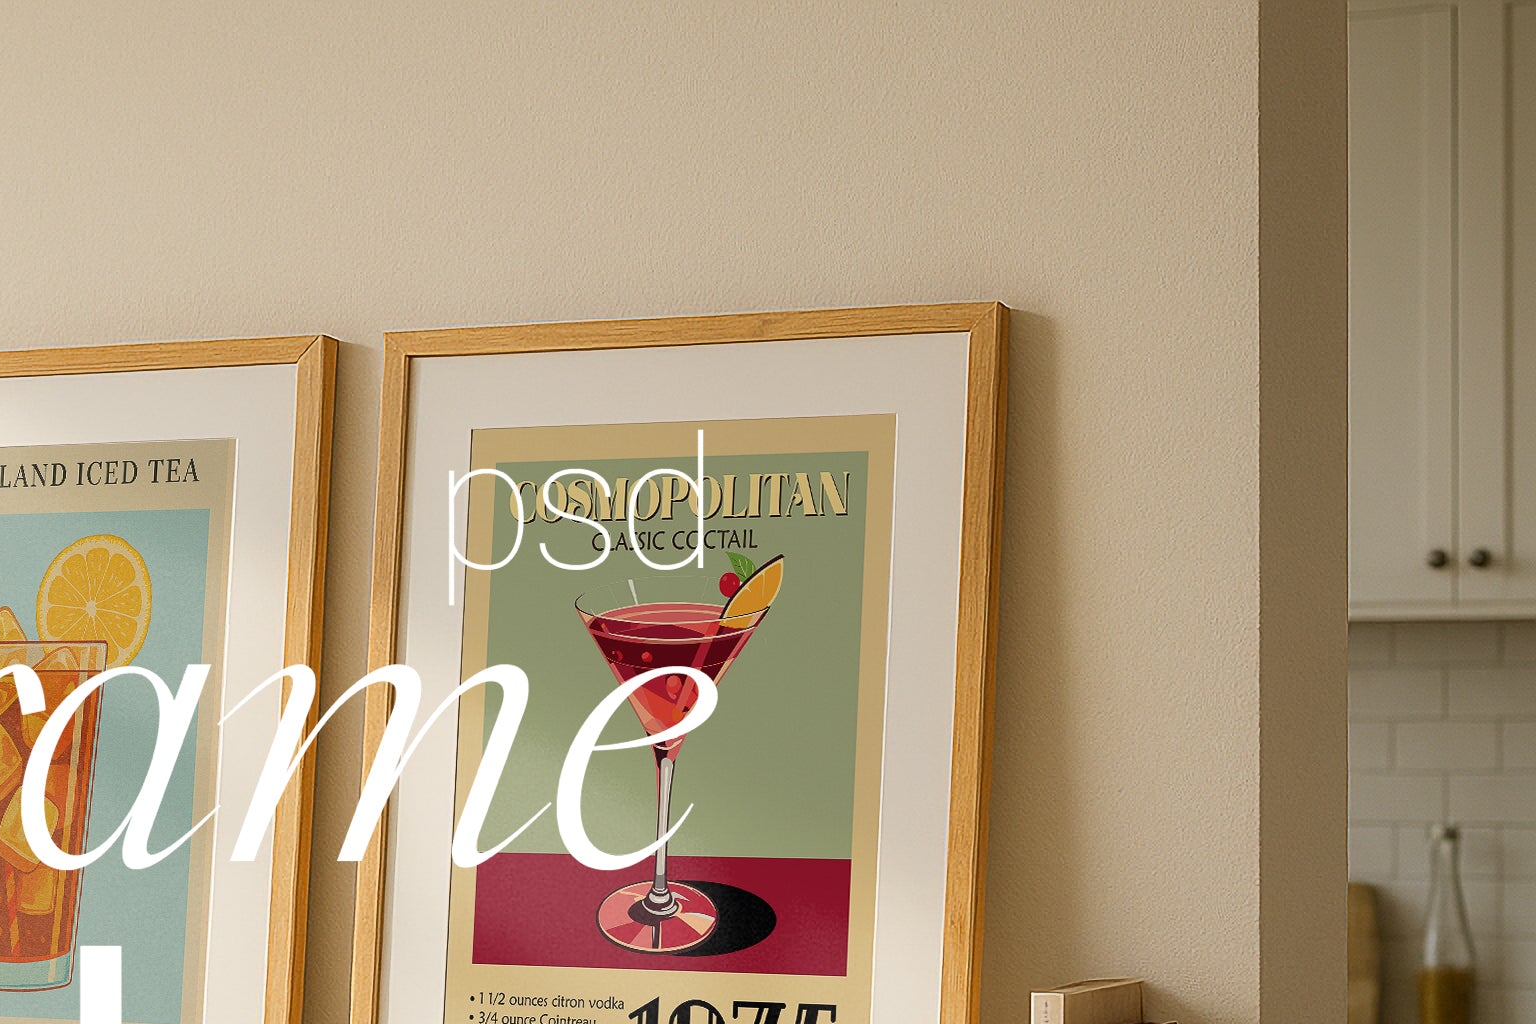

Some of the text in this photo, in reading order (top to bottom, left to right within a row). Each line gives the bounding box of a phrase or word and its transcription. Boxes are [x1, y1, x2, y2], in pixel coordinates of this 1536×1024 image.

[75, 459, 139, 487] ICED
[147, 457, 201, 484] TEA
[509, 470, 851, 525] COSMOPOLITAN
[592, 529, 759, 551] CASIC COCTAIL
[488, 992, 506, 1006] 1/2
[509, 995, 549, 1008] ounces
[551, 994, 585, 1009] citron
[588, 996, 625, 1011] vodka
